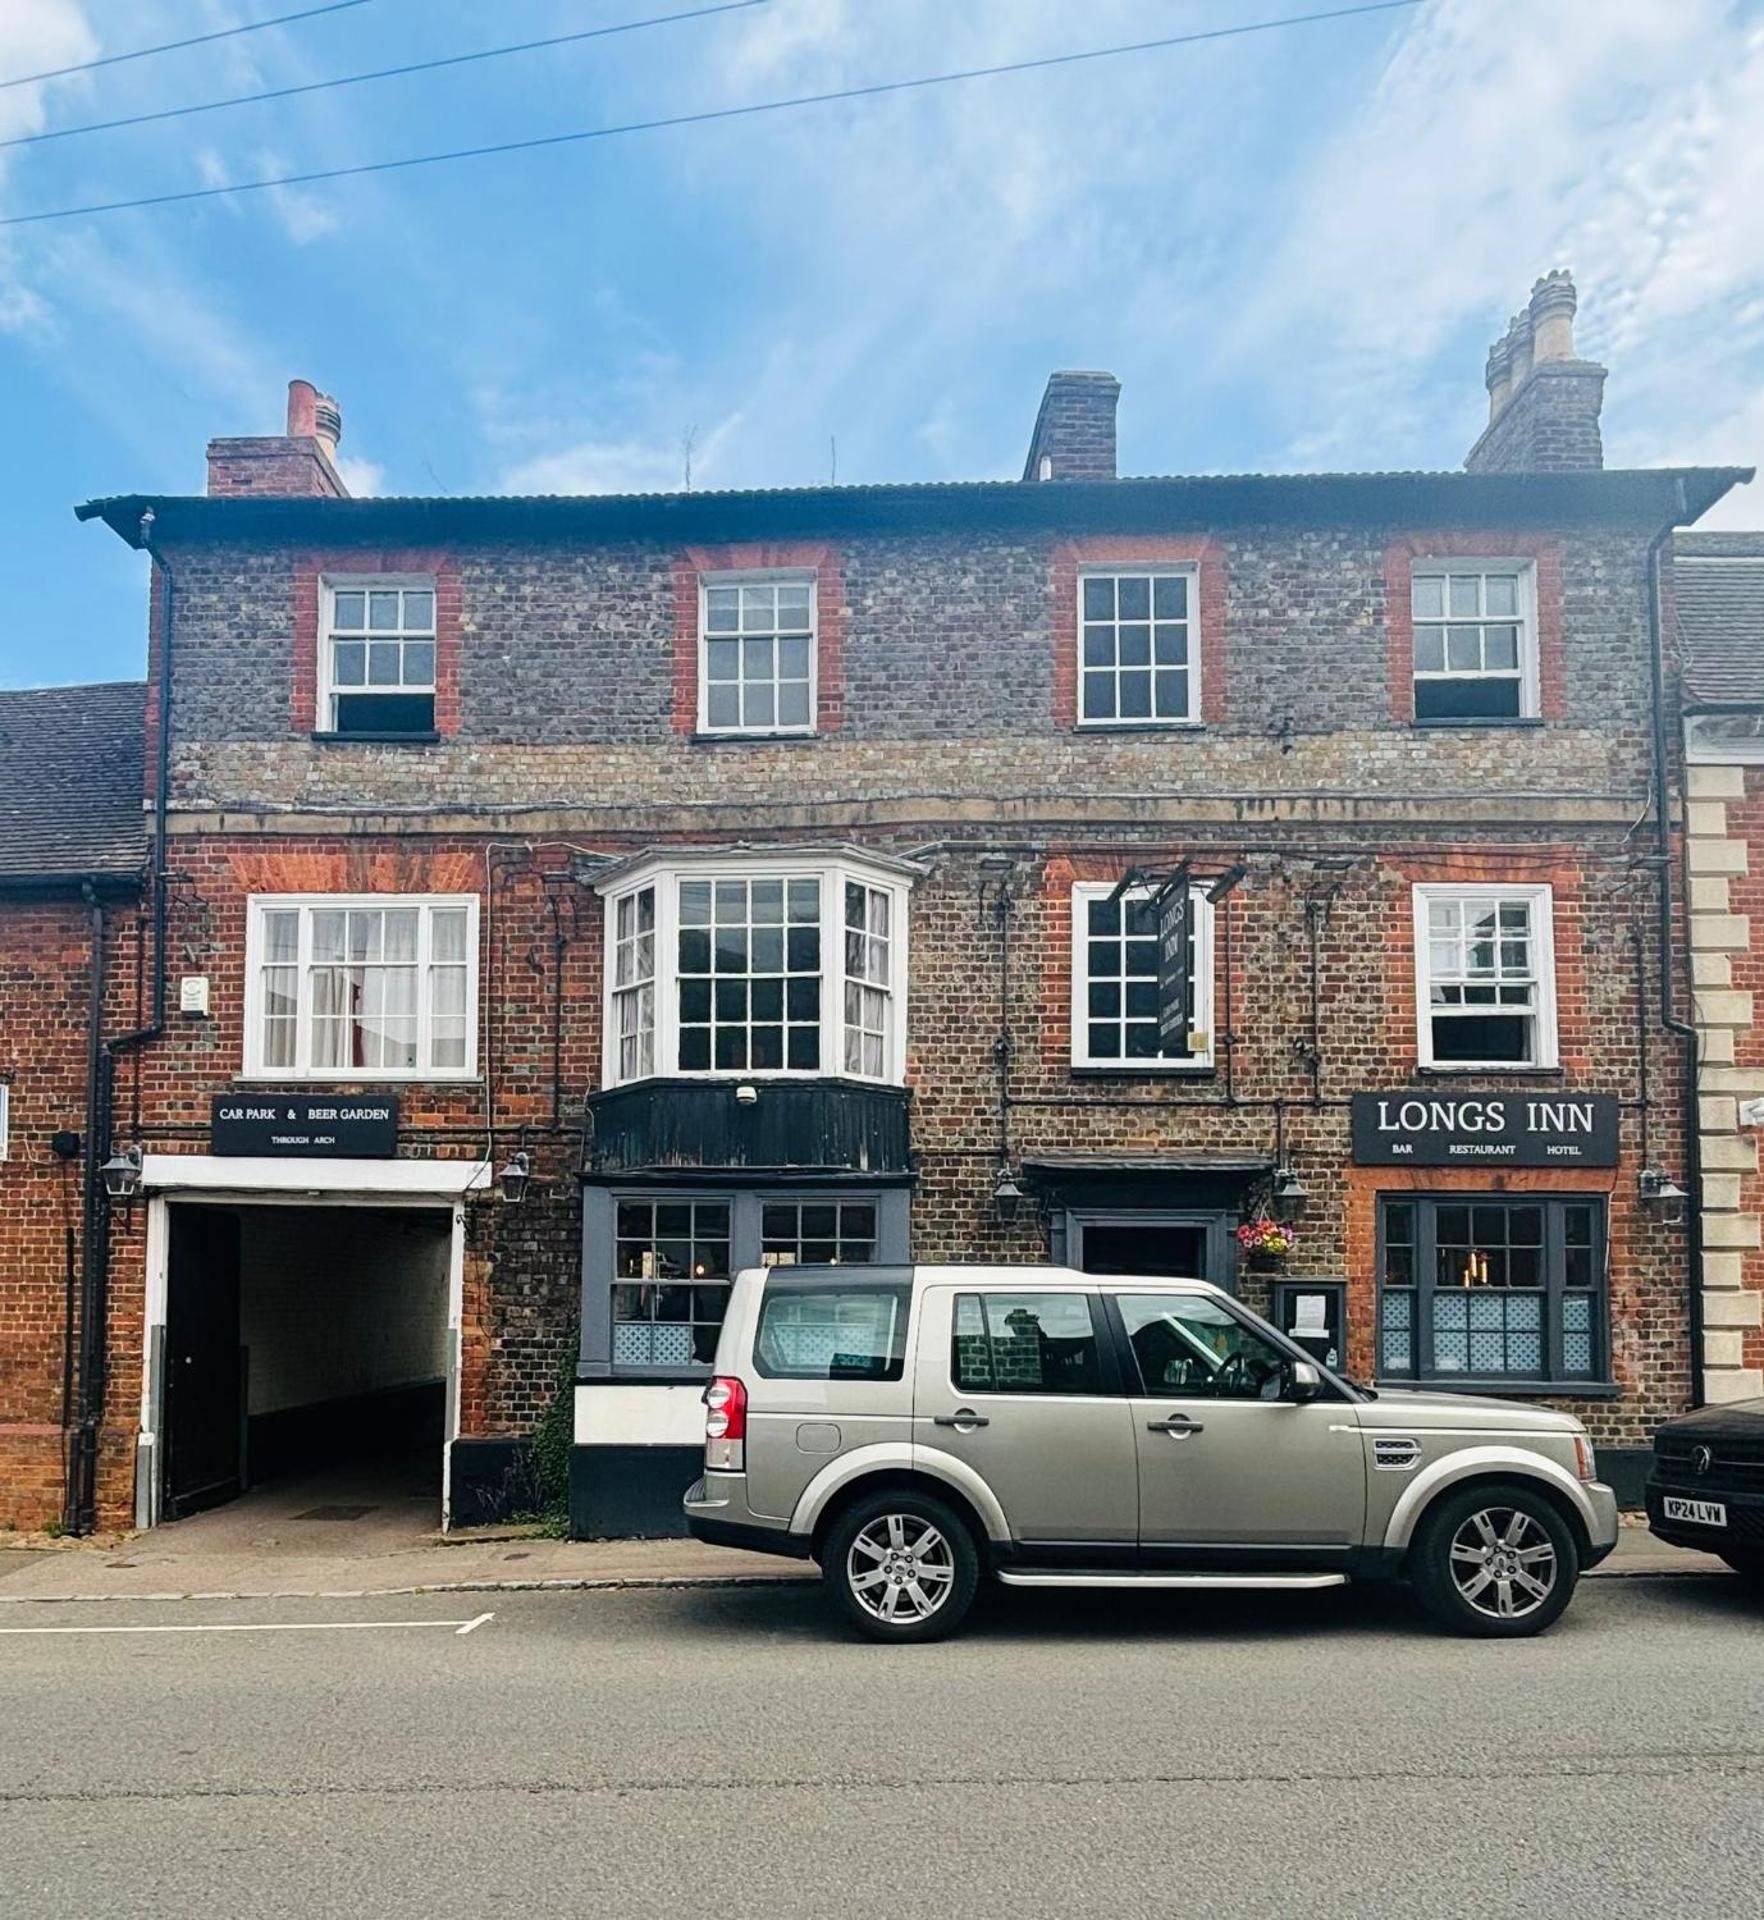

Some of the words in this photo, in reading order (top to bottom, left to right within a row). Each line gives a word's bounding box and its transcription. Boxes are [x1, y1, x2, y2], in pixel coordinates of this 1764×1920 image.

[1160, 897, 1185, 939] LONGS
[219, 1108, 244, 1120] CAR
[246, 1108, 276, 1120] PARK
[287, 1108, 296, 1120] &
[307, 1108, 338, 1120] BEER
[339, 1108, 389, 1120] GARDEN
[1377, 1101, 1505, 1132] LONGS
[1527, 1103, 1594, 1133] INN
[271, 1136, 309, 1144] THROUGH
[313, 1136, 335, 1144] ARCH
[1392, 1144, 1413, 1154] BAR
[1449, 1144, 1516, 1155] RESTAURANT
[1547, 1145, 1582, 1155] HOTEL
[1668, 1500, 1696, 1519] KP24
